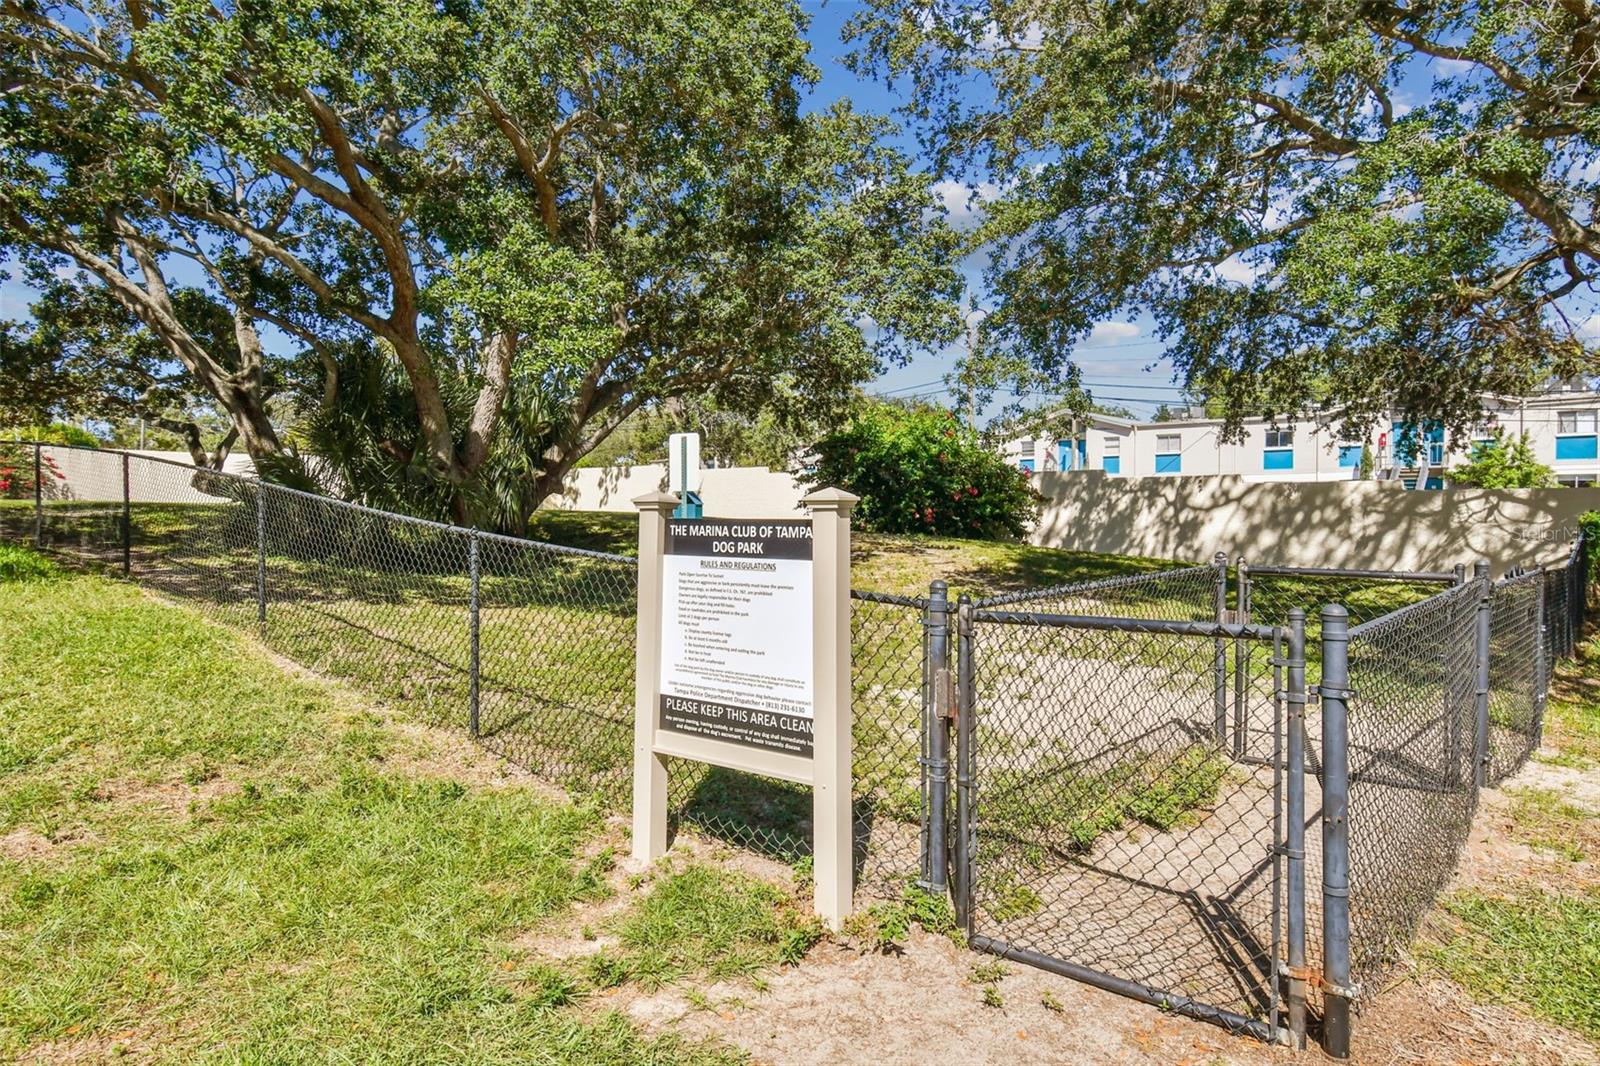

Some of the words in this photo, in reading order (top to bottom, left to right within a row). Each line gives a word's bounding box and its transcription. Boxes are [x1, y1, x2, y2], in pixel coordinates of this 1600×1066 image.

[670, 525, 687, 536] THE
[689, 525, 730, 537] MARINA
[732, 526, 756, 538] CLUB
[759, 526, 773, 538] OF
[775, 526, 813, 539] TAMPA
[712, 542, 735, 553] DOG
[738, 542, 764, 554] PARK
[700, 560, 718, 568] RULES
[720, 561, 732, 569] AND
[734, 561, 776, 571] REGULATIONS
[704, 692, 733, 701] Department
[734, 696, 760, 706] Dispatcher
[765, 701, 779, 710] (813)
[666, 698, 698, 714] PLEASE
[700, 703, 724, 718] KEEP
[726, 708, 748, 722] THIS
[750, 712, 778, 728] AREA
[780, 717, 814, 734] CLEAN
